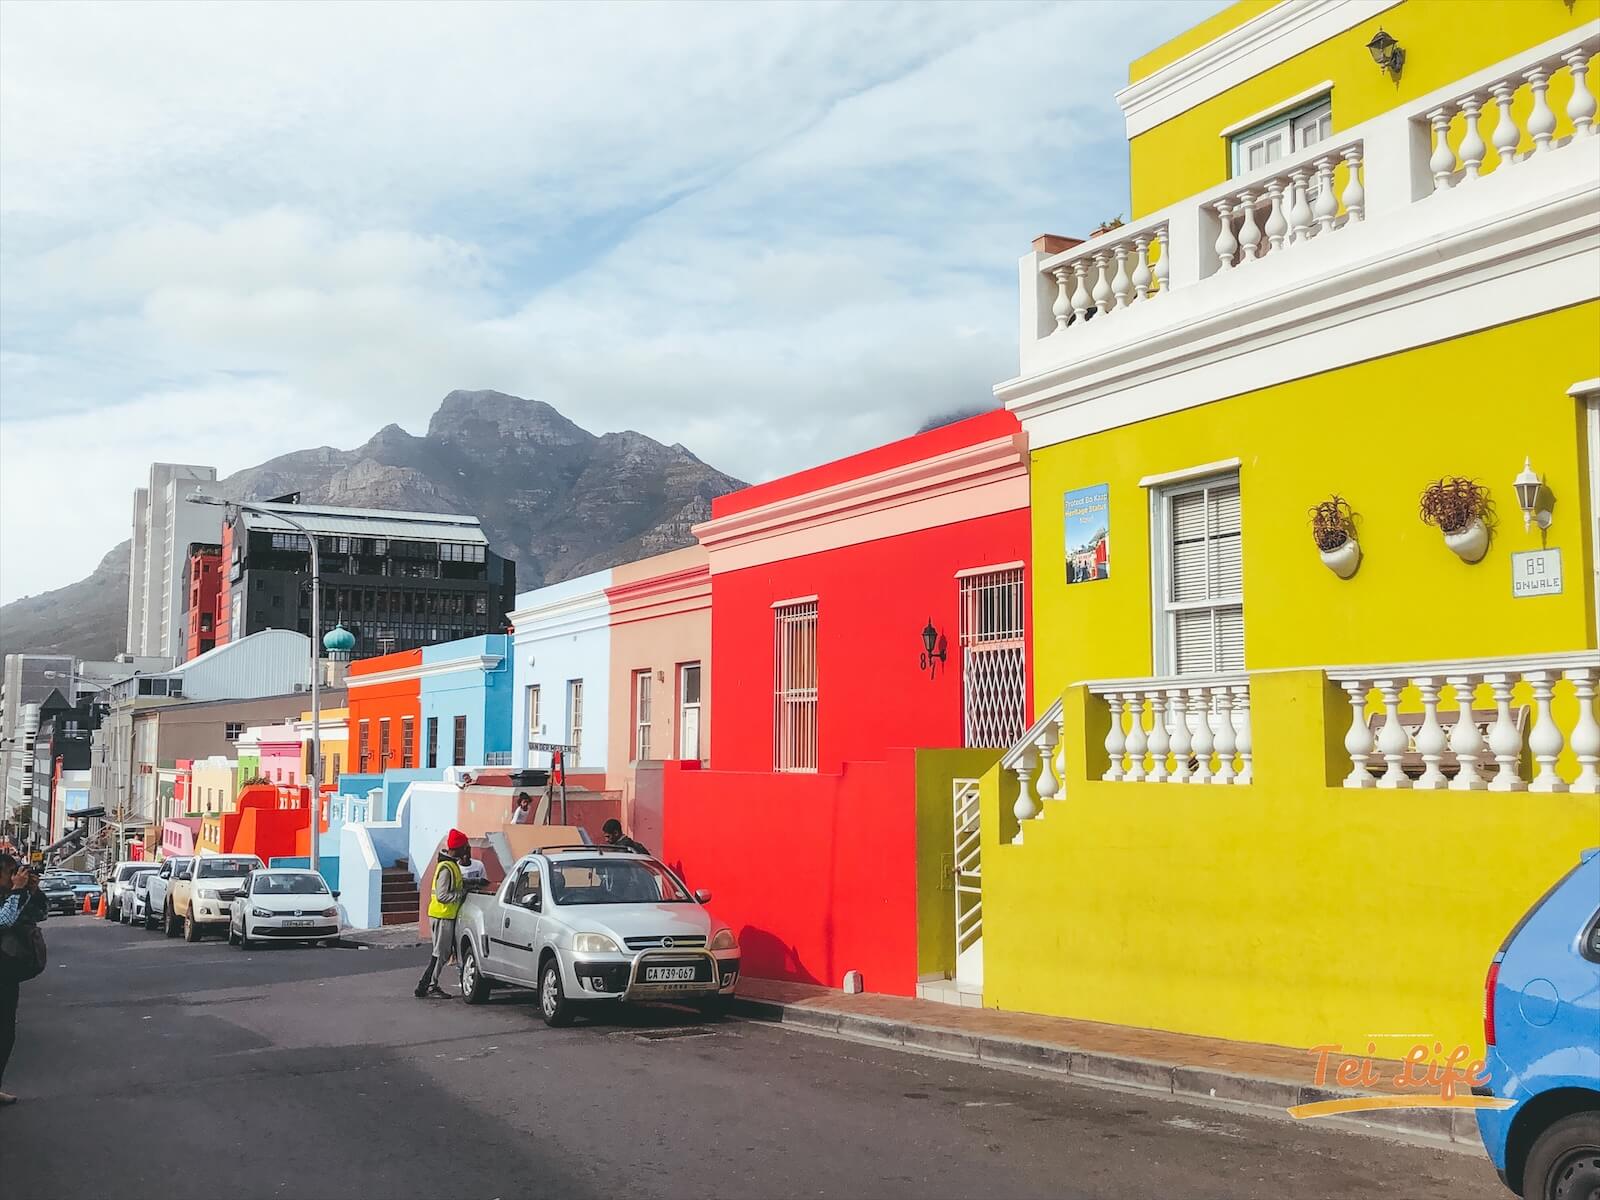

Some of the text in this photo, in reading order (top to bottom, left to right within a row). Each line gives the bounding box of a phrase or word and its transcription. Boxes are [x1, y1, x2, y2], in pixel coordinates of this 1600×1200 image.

[1526, 557, 1545, 575] 89
[1515, 577, 1560, 591] ONWALE
[920, 652, 936, 680] 87
[647, 968, 658, 980] CA
